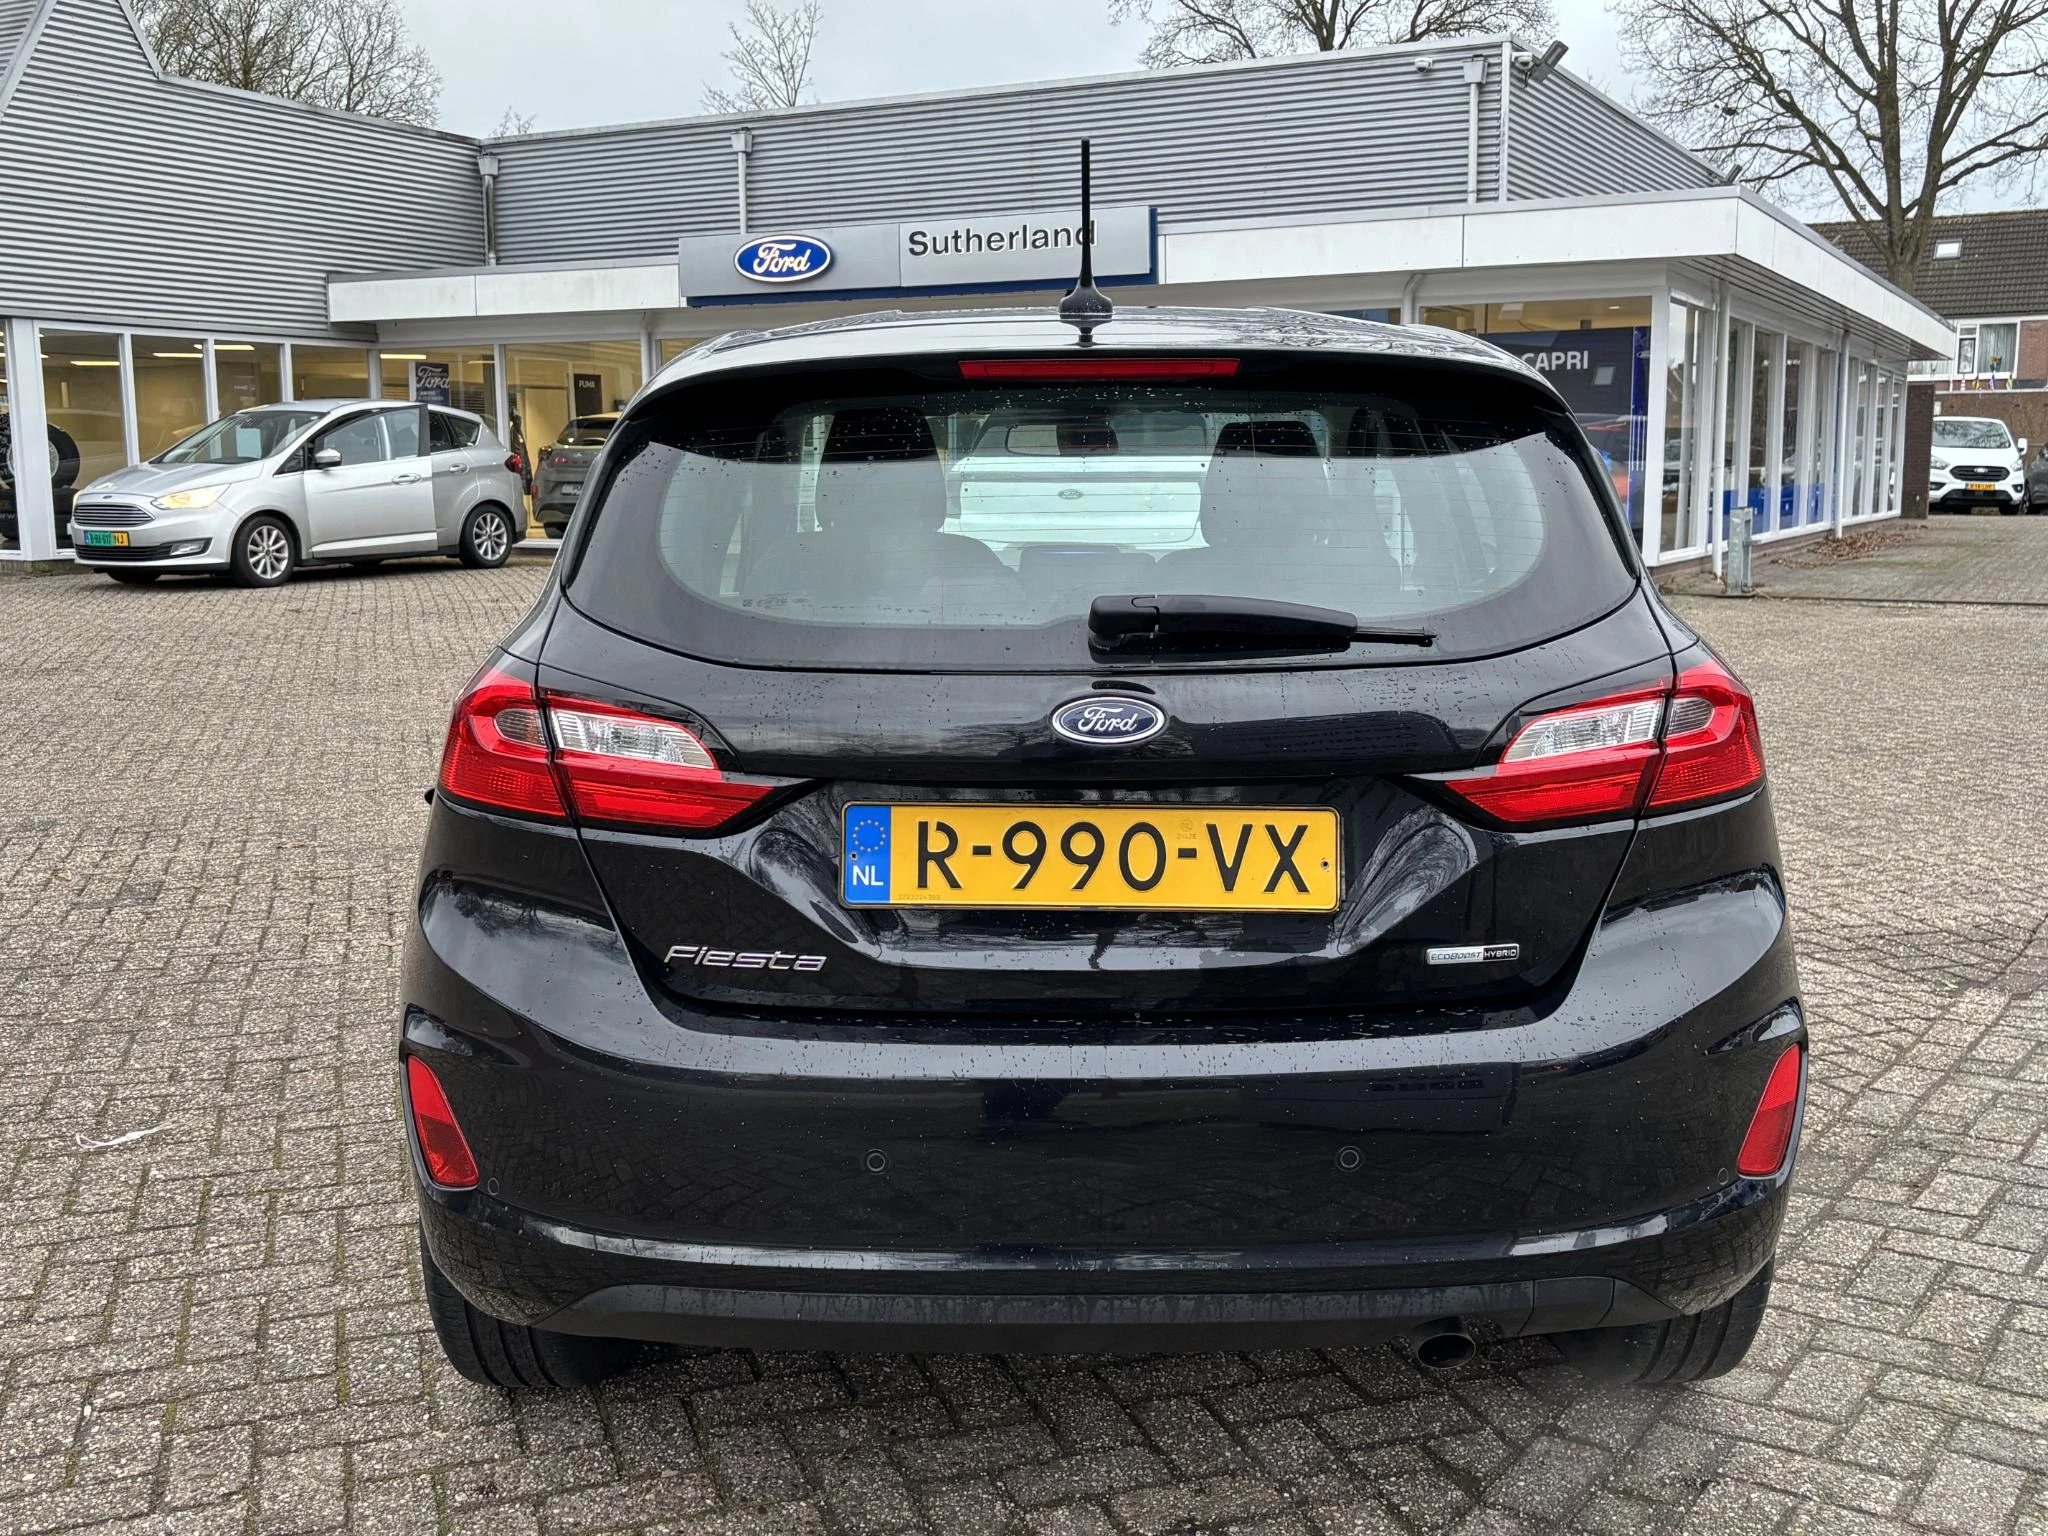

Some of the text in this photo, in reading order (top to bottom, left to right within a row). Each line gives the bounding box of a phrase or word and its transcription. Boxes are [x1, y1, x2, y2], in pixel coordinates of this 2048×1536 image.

[908, 219, 1096, 257] Sutherland
[751, 242, 812, 275] Ford
[415, 365, 451, 389] Ford
[1077, 706, 1138, 732] Ford
[916, 820, 1310, 894] R-990-VX
[851, 864, 884, 887] NL
[663, 945, 827, 972] Fiesta
[1484, 949, 1517, 958] HYBRID
